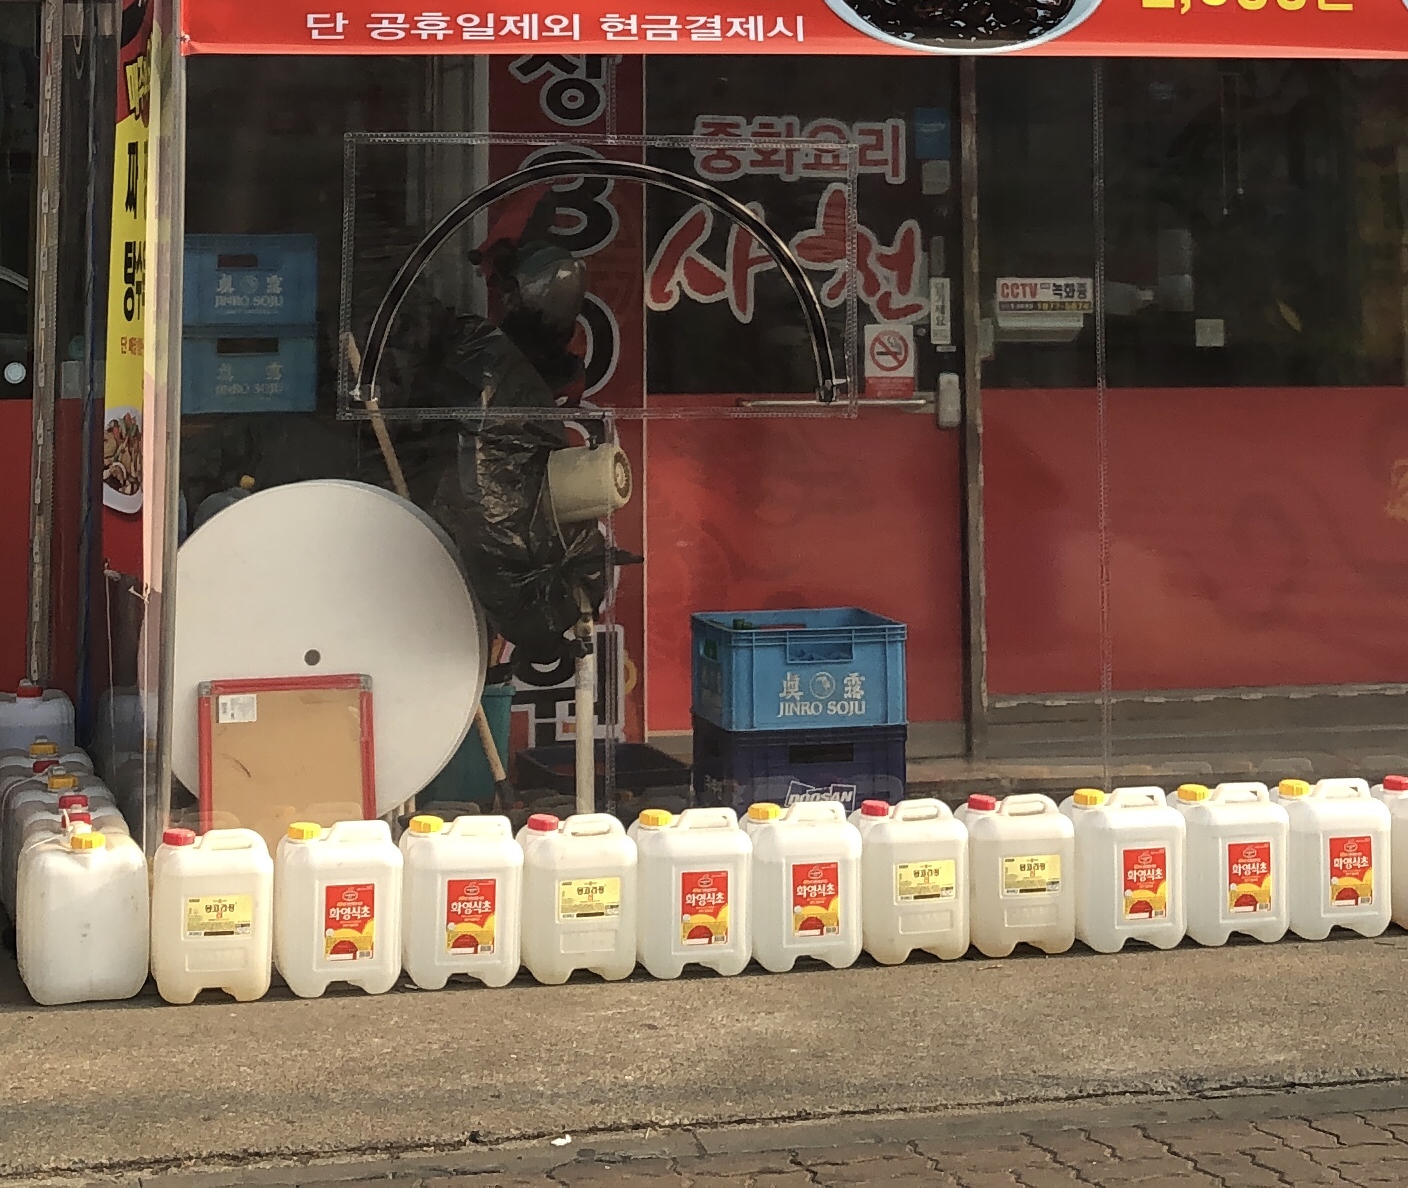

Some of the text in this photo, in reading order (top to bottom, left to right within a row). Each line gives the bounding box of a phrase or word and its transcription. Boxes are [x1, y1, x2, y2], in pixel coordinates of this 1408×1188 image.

[305, 14, 804, 43] 단 공휴일제외 현금결제시
[692, 114, 905, 184] 중화요리
[645, 182, 930, 325] 사천
[1000, 282, 1038, 299] CCTV
[253, 295, 284, 307] SOJU
[777, 700, 866, 718] JINRO SOJU
[450, 899, 492, 915] 화영식초
